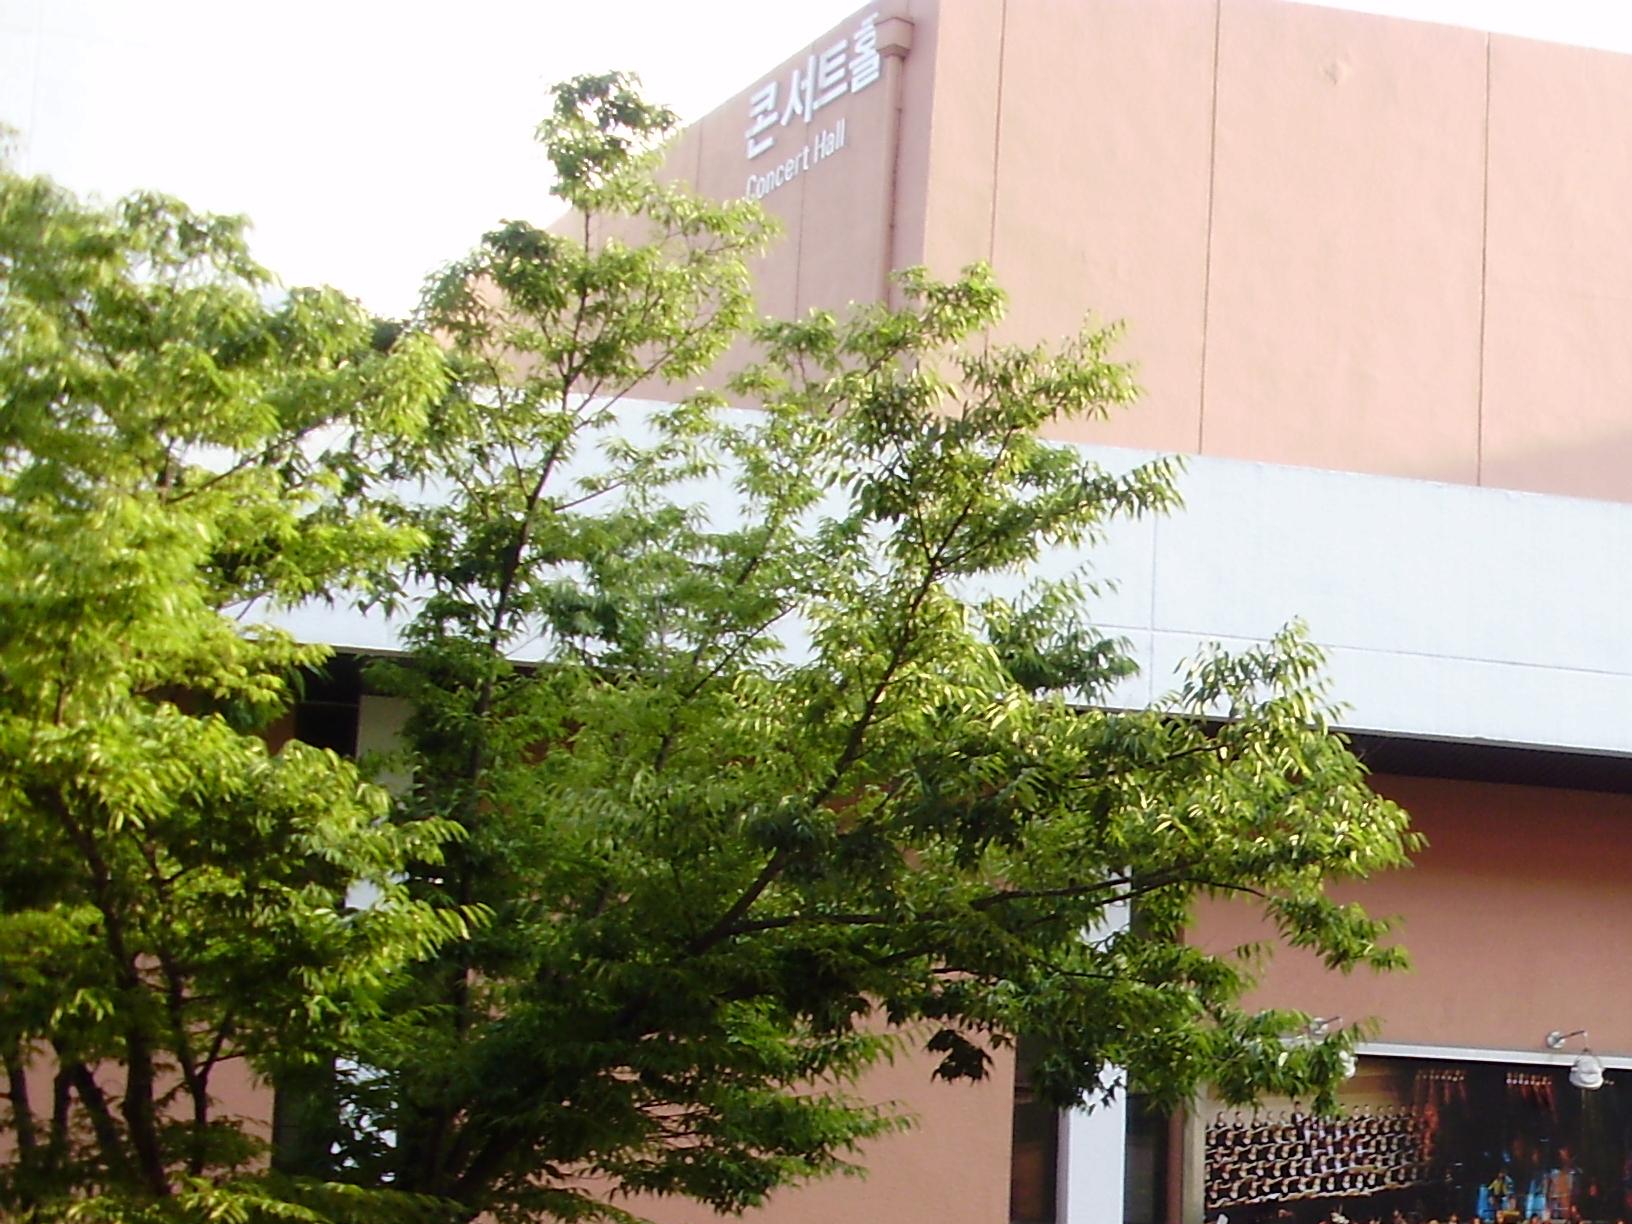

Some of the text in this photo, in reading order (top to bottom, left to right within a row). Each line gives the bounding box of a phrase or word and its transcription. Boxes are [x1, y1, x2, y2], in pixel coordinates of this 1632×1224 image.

[745, 12, 882, 160] 콘서트홀
[745, 118, 846, 200] Concert Hall
